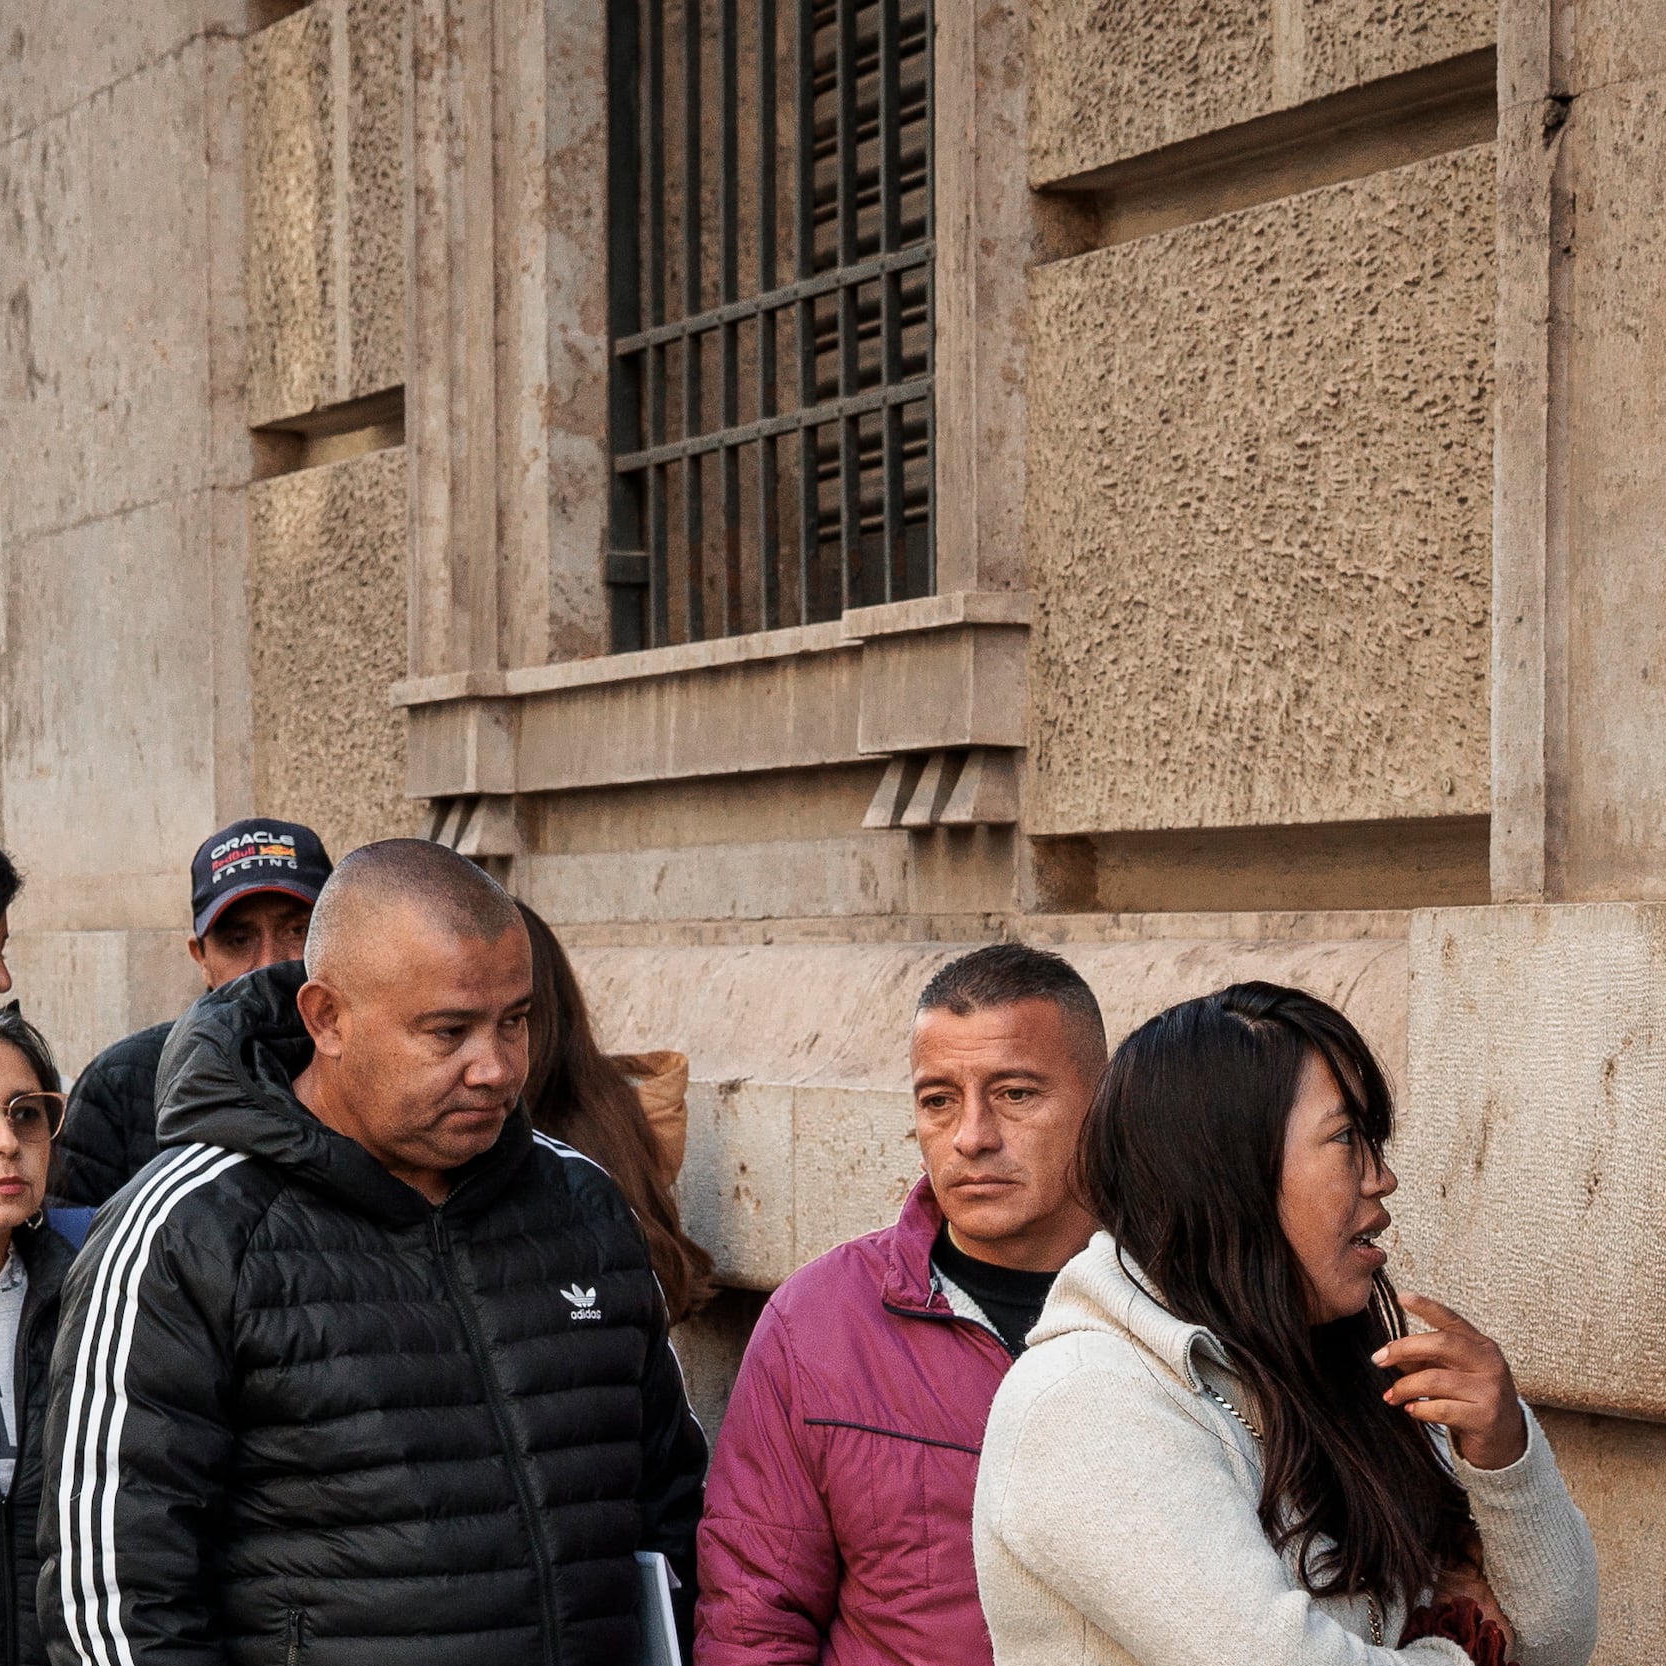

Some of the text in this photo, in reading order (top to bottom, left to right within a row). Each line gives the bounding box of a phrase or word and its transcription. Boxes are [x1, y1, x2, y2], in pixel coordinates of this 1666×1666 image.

[210, 831, 295, 860] ORACLE
[212, 858, 298, 884] RACING
[570, 1308, 602, 1320] adidas
